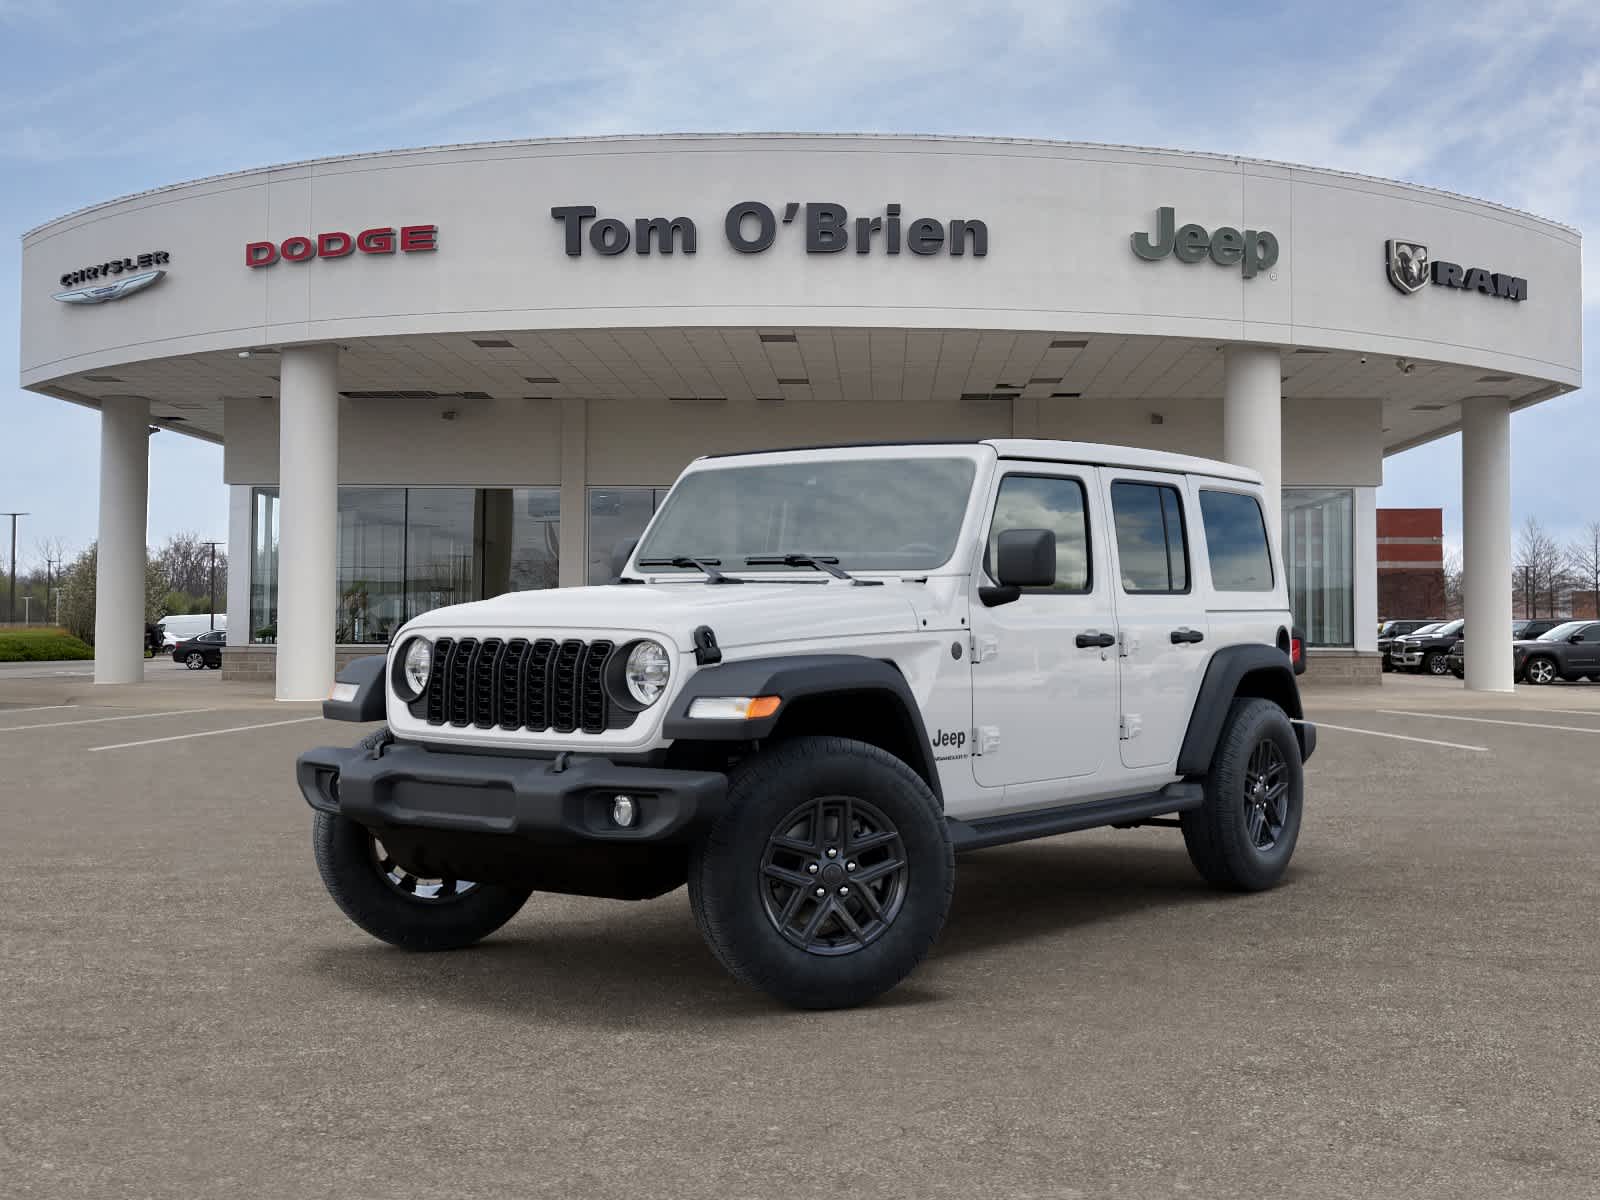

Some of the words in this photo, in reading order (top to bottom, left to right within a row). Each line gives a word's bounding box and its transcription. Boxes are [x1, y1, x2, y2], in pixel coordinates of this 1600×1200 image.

[246, 224, 438, 268] DODGE
[551, 205, 697, 256] Tom
[725, 201, 988, 256] O'Brien
[1131, 207, 1279, 278] Jeep
[61, 250, 170, 287] CHRYSLER
[1430, 260, 1528, 302] RAM
[932, 729, 966, 748] Jeep
